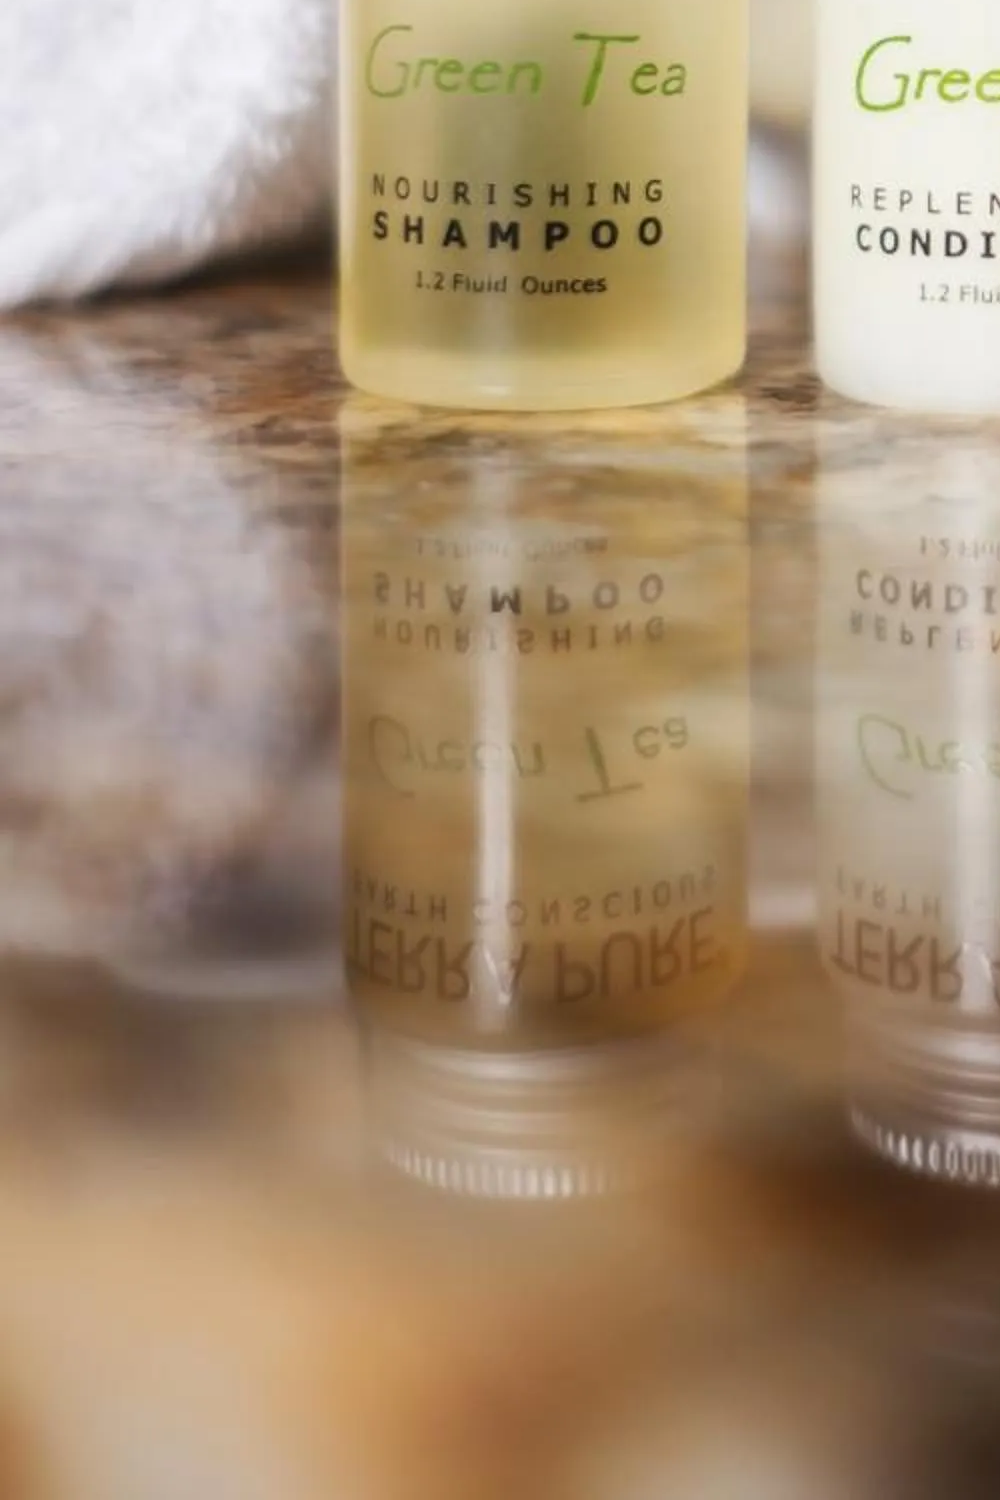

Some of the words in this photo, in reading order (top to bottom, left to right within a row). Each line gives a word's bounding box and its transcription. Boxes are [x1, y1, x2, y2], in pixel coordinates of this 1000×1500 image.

[365, 25, 543, 99] Green
[572, 32, 688, 108] Tea
[372, 173, 665, 206] NOURISHING
[372, 212, 665, 251] SHAMPOO
[415, 272, 445, 291] 1.2
[451, 273, 508, 294] Fluid
[521, 275, 607, 295] Ounces
[918, 284, 950, 302] 1.2
